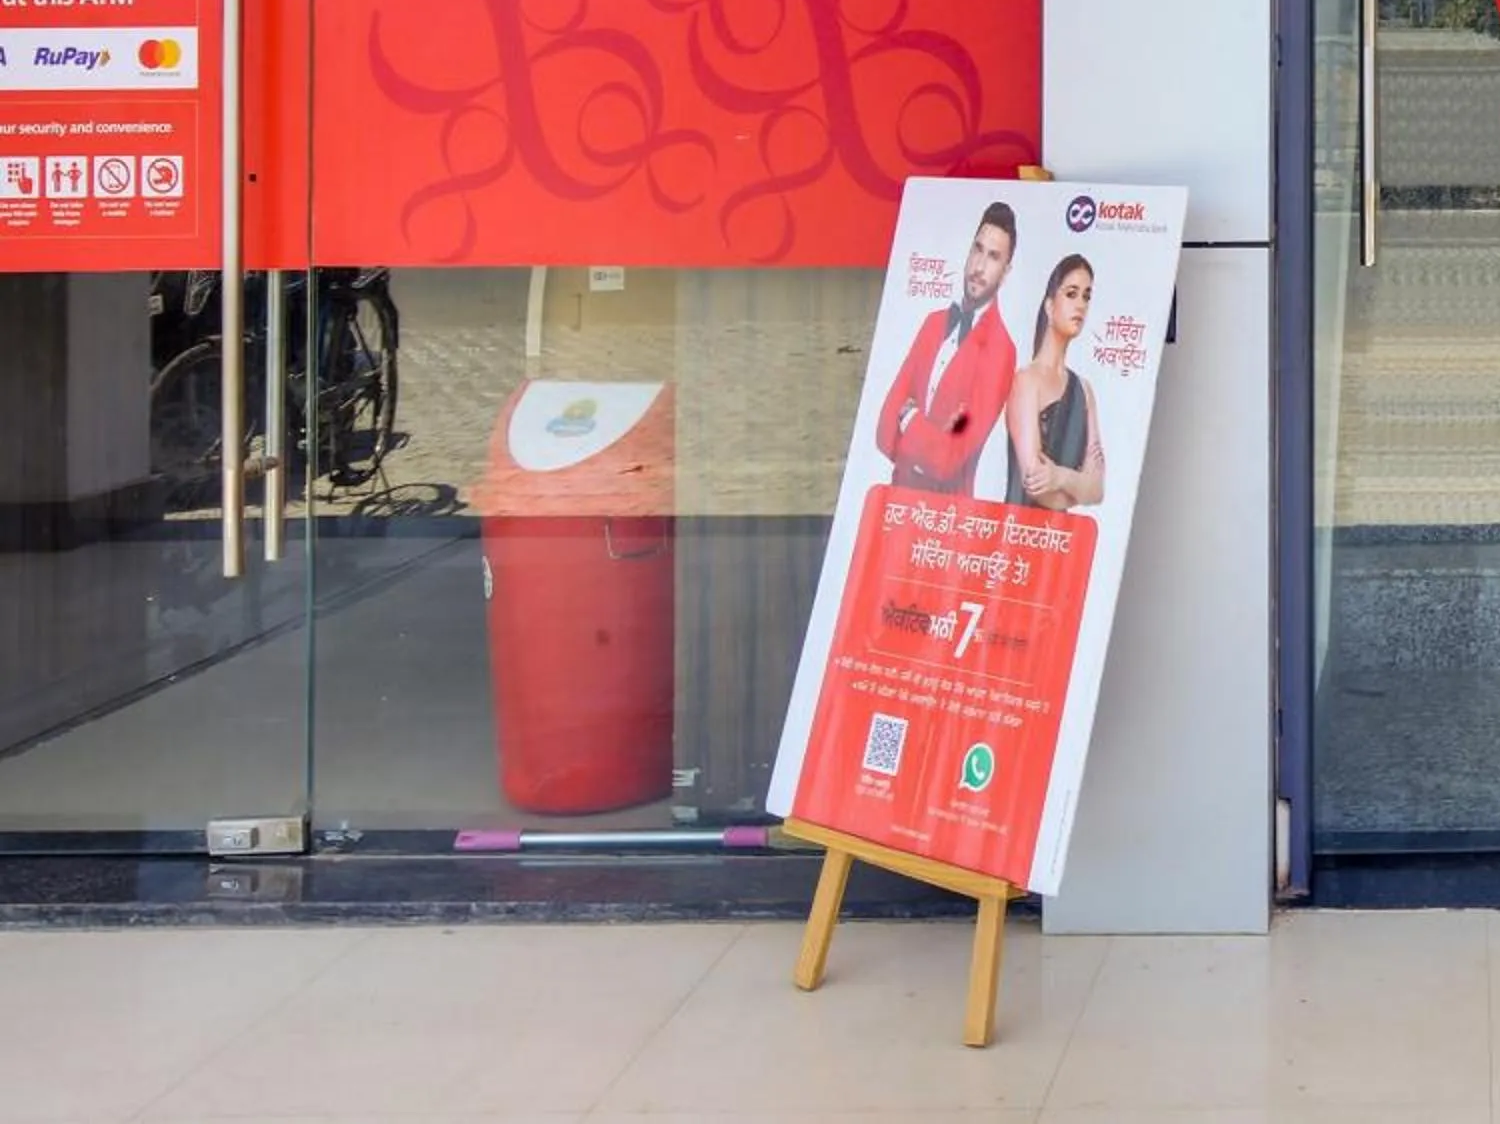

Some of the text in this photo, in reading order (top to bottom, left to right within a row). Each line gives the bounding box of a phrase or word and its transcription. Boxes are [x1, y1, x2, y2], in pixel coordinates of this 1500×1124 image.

[34, 47, 101, 70] RuPay
[19, 121, 66, 137] security
[70, 120, 93, 134] and
[96, 122, 173, 134] convenience
[1098, 202, 1145, 220] kotak
